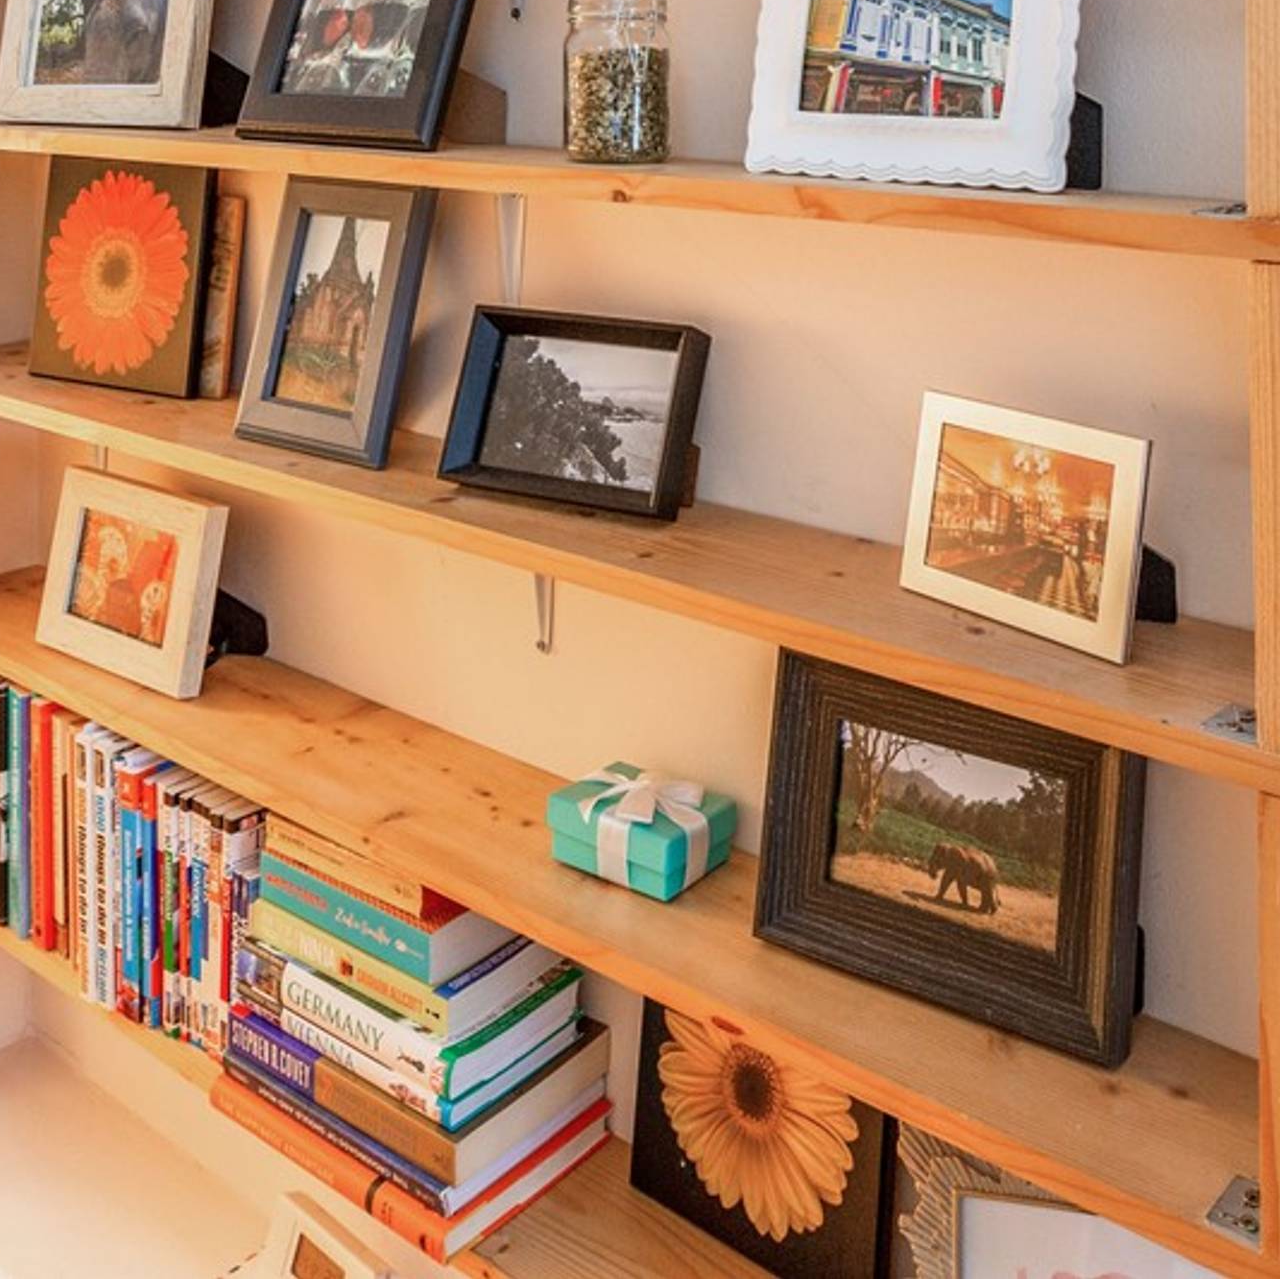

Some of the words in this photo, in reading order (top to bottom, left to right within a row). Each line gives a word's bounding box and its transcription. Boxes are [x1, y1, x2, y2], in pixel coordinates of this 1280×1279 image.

[95, 794, 107, 833] 1000
[77, 825, 88, 875] things
[95, 833, 107, 886] things
[287, 978, 384, 1052] GERMANY
[287, 1013, 355, 1072] VIENNA
[231, 1019, 269, 1065] STEPHEN
[280, 1047, 311, 1090] COVEY
